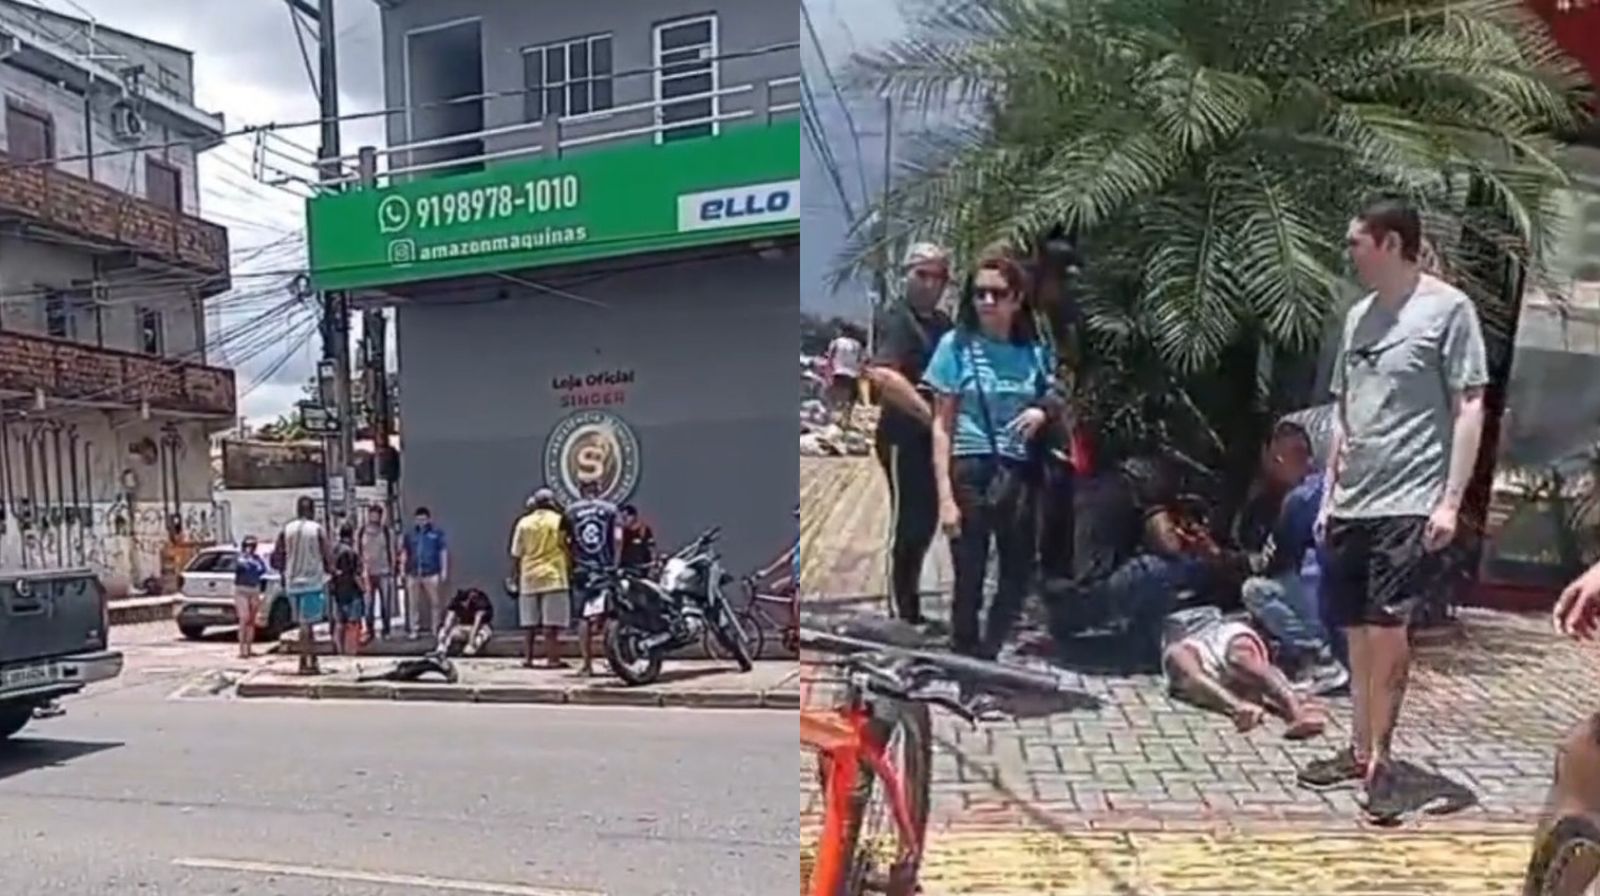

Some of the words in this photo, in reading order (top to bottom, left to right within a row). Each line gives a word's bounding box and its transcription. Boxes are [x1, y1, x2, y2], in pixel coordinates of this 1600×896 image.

[416, 174, 579, 229] 9198978-1010
[419, 226, 587, 261] amazonmaquinas
[552, 374, 582, 391] Loja
[586, 370, 635, 387] Oficial
